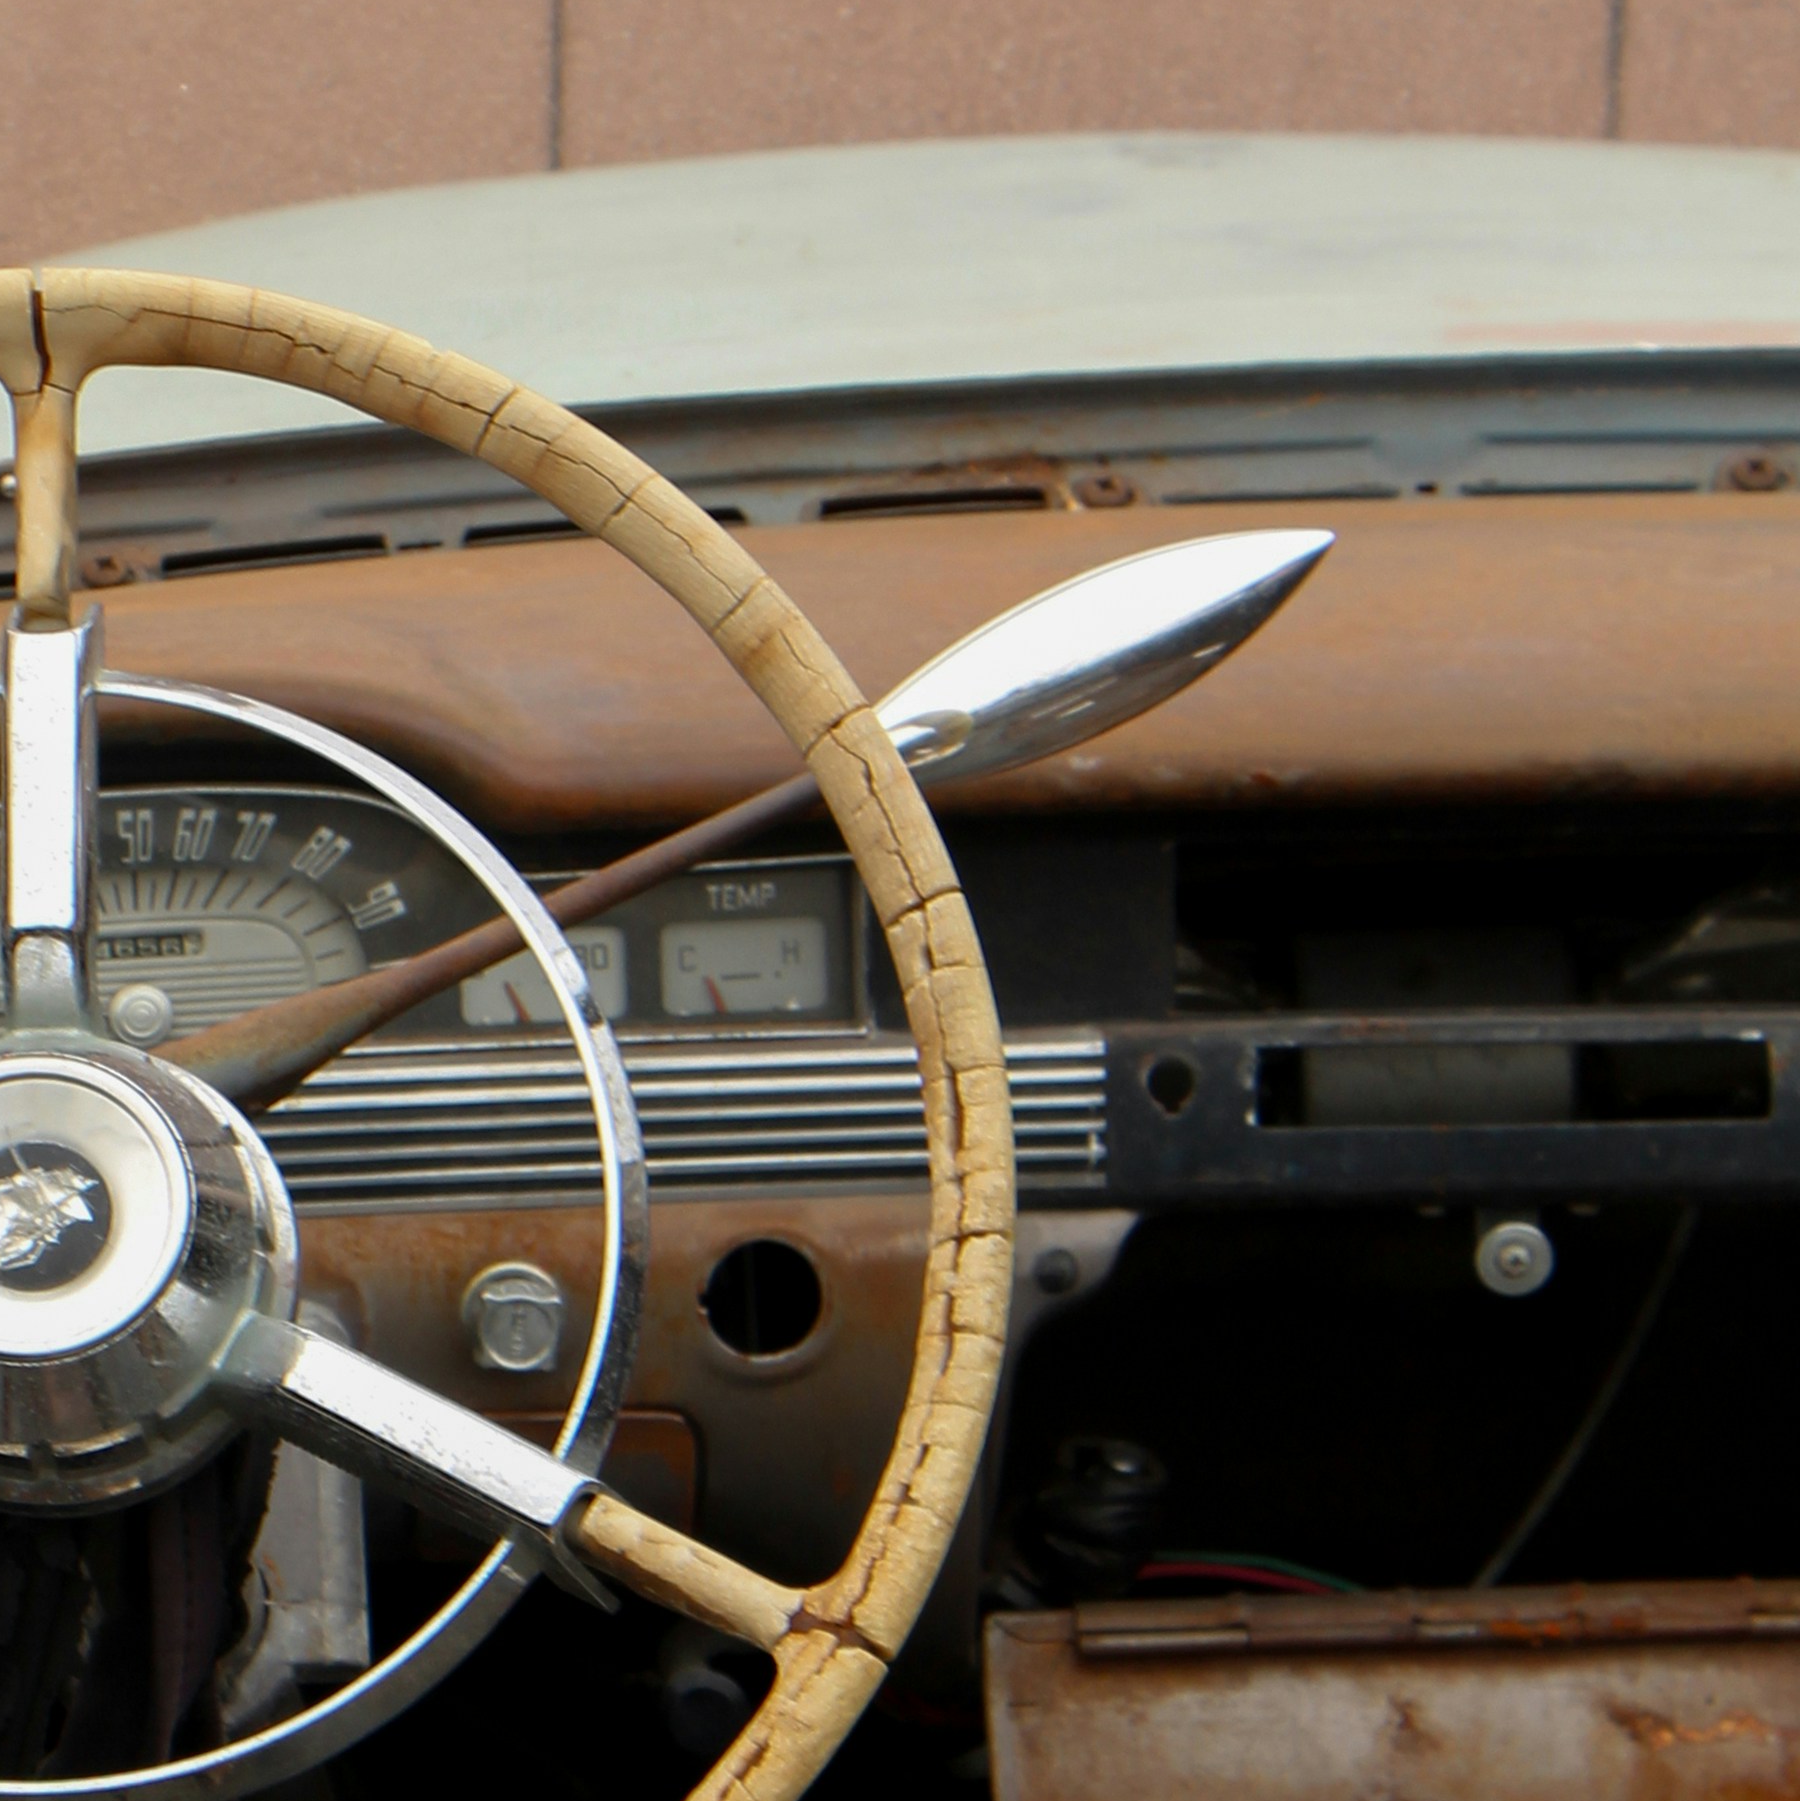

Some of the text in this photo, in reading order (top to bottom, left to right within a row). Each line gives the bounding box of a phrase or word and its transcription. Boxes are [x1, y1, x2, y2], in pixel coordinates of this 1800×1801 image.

[116, 808, 153, 864] 50
[172, 807, 219, 862] 60
[231, 811, 278, 862] 70
[290, 825, 353, 880] 80
[349, 880, 407, 930] 90
[705, 882, 778, 911] TEMP
[678, 938, 801, 972] C H
